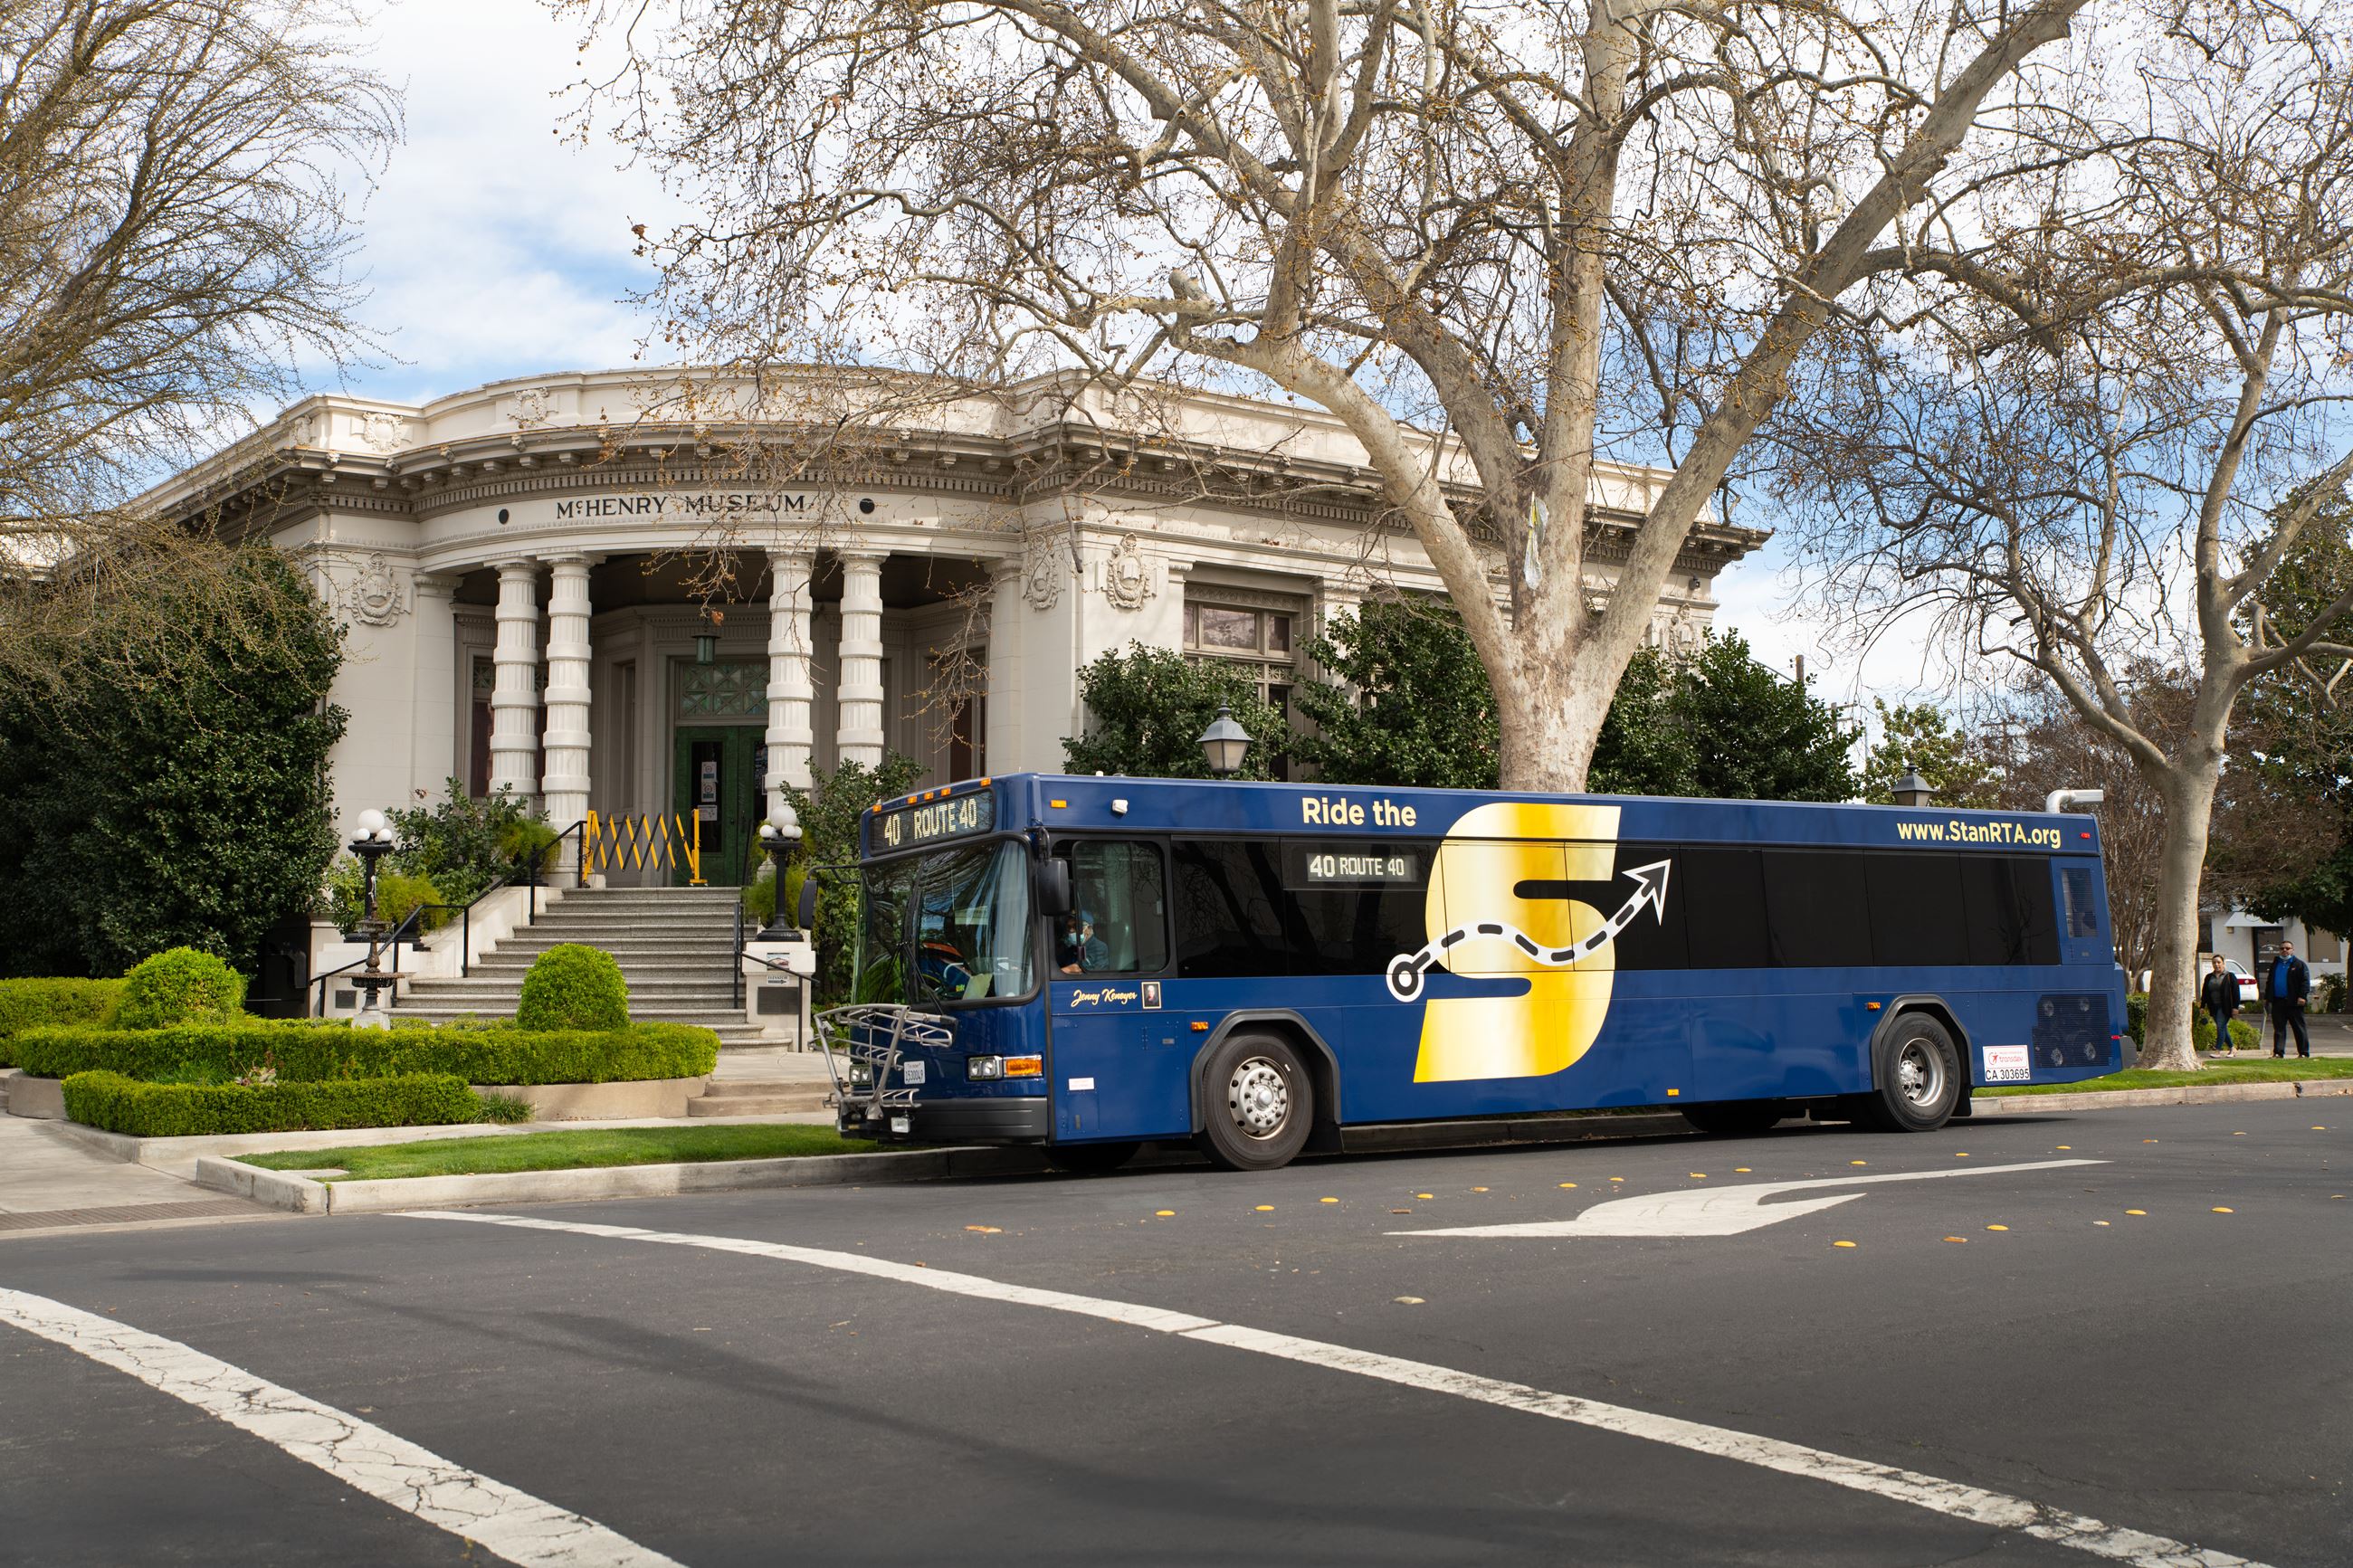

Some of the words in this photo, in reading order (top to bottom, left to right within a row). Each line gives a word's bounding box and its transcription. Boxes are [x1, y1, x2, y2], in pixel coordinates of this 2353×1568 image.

[685, 494, 805, 513] MUSEUM
[884, 813, 900, 847] 40
[913, 803, 957, 840] ROUTE
[959, 798, 977, 828] 40
[1301, 797, 1365, 825] Ride
[1372, 799, 1416, 827] the
[1896, 820, 2062, 850] www.StanRTA.org
[1310, 855, 1336, 878] 40
[1339, 857, 1384, 876] ROUTE
[1387, 858, 1405, 876] 40
[1071, 989, 1100, 1008] Jenny
[1101, 988, 1138, 1005] Kenoyer
[1986, 1069, 1998, 1080] CA
[2000, 1069, 2030, 1079] 303695
